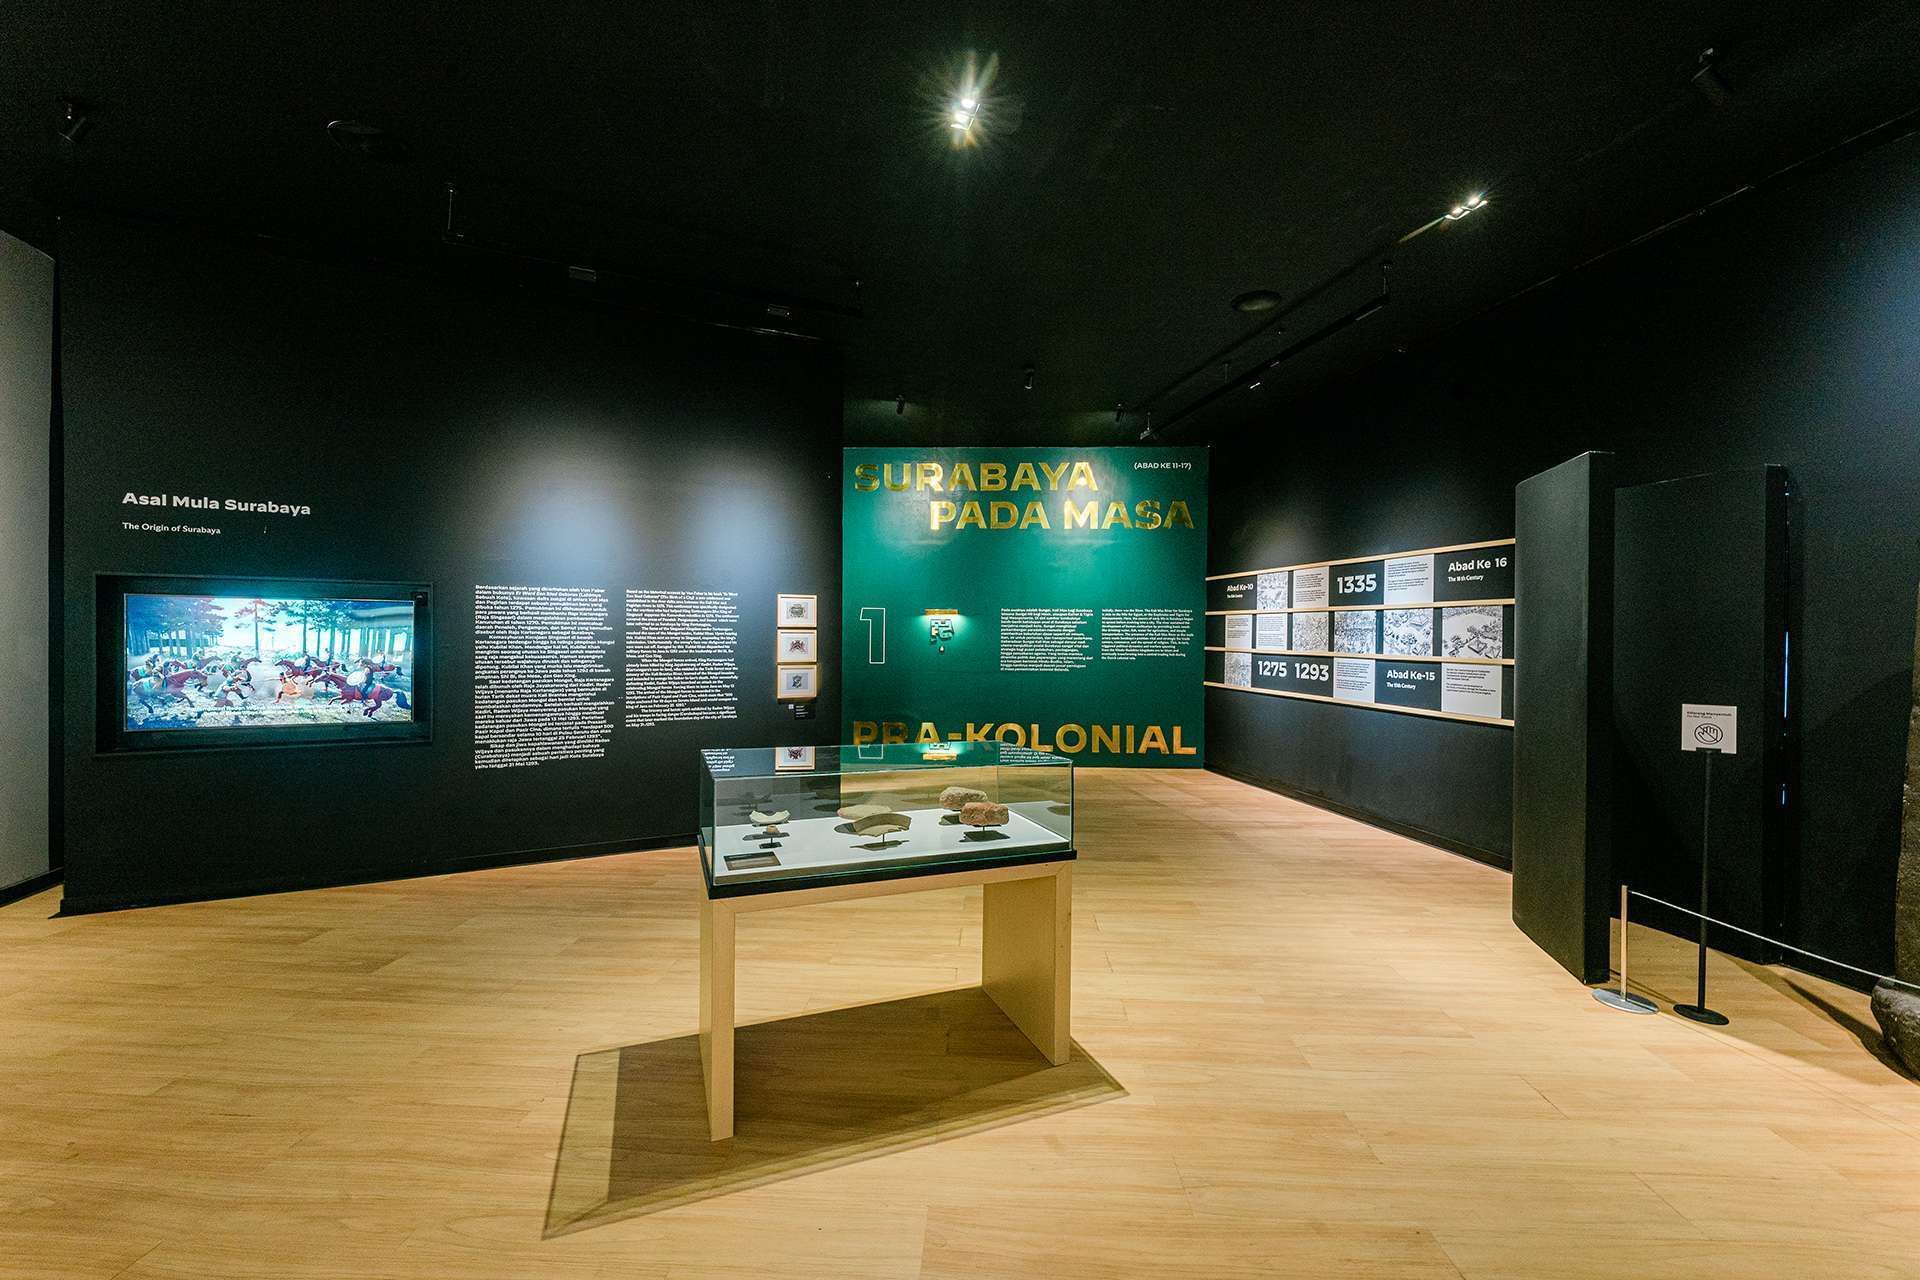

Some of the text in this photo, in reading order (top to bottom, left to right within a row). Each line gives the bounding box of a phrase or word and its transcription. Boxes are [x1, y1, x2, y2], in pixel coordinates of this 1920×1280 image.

[1134, 462, 1160, 470] (ABAD
[1172, 462, 1192, 471] 11-17)
[854, 462, 1099, 492] SURABAYA
[122, 492, 311, 516] Asal Mula Surabaya
[929, 500, 1194, 530] PADA MASA
[142, 523, 169, 532] Origin
[182, 526, 222, 535] Surabaya
[1448, 557, 1508, 572] Abad Ke 16
[1337, 574, 1377, 594] 1335
[860, 607, 886, 664] 1
[1258, 660, 1287, 678] 1275
[1295, 662, 1329, 682] 1293
[1386, 670, 1436, 680] Abad Ke-15
[853, 720, 1197, 755] PRA-KOLONIAL
